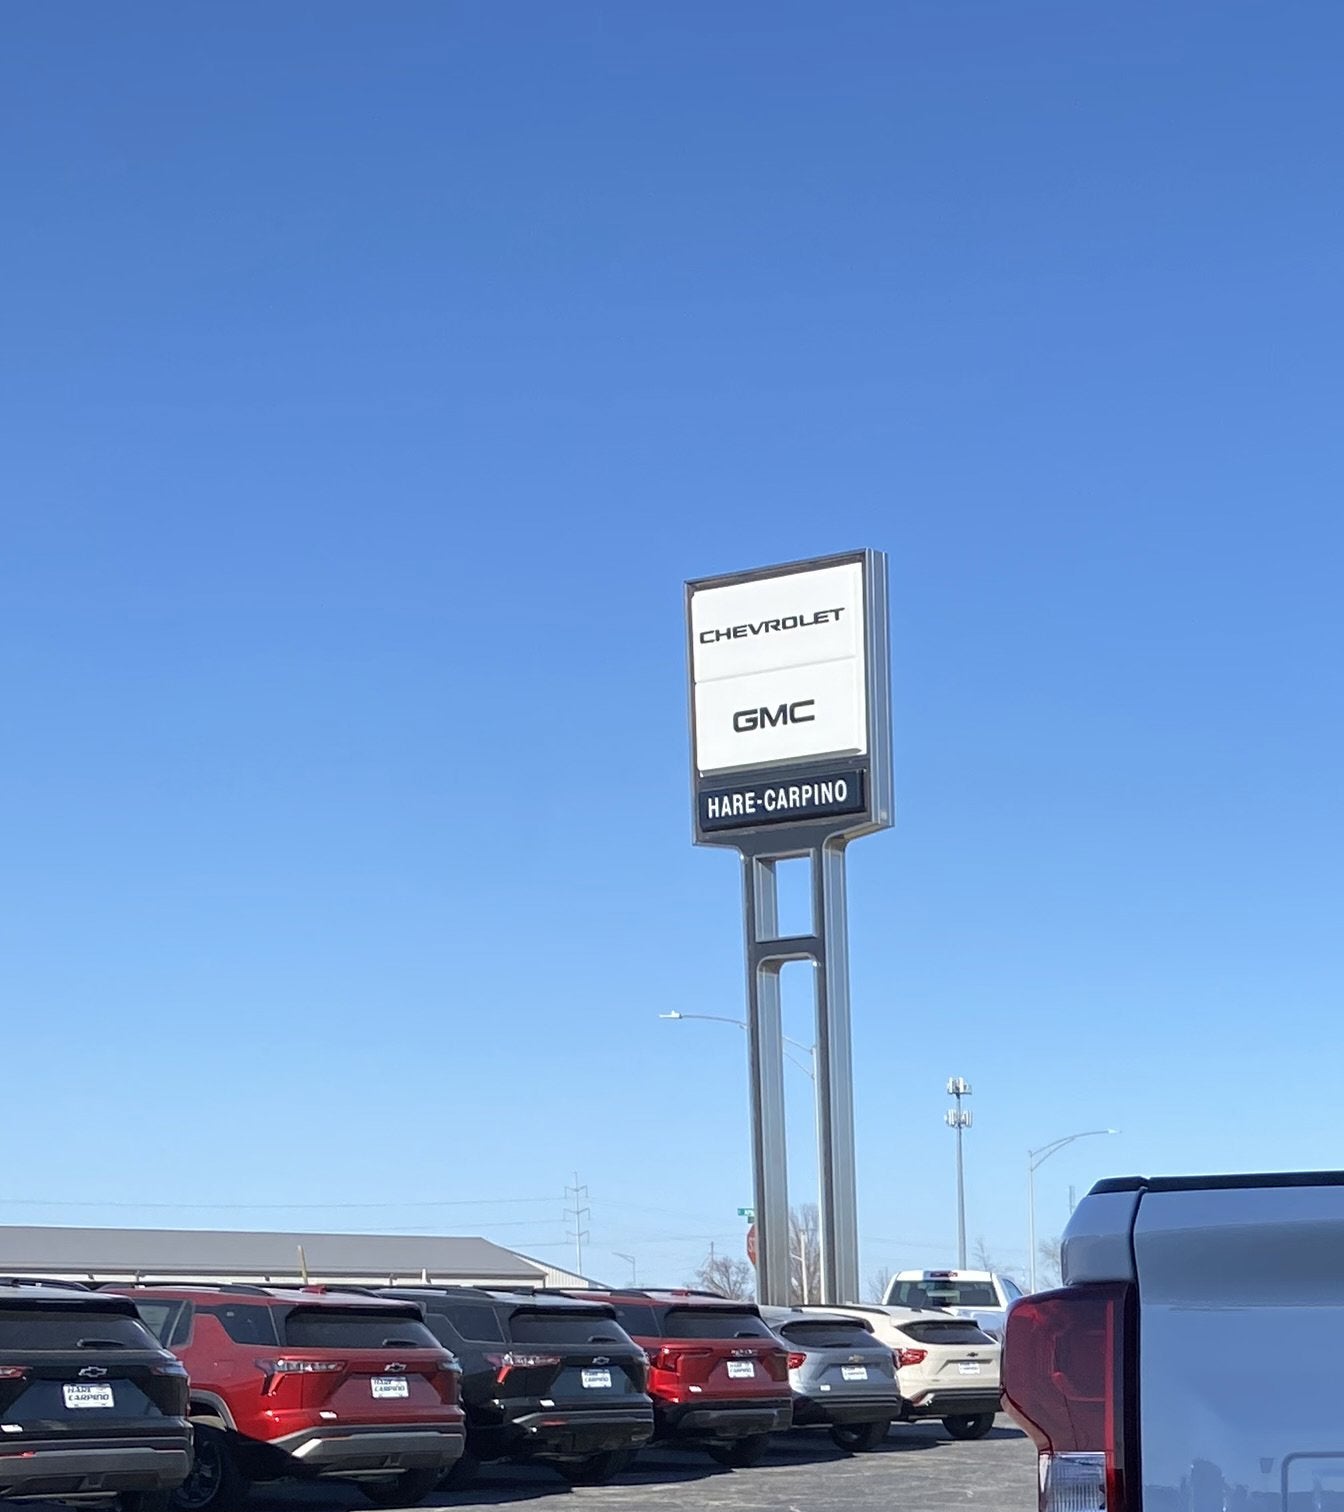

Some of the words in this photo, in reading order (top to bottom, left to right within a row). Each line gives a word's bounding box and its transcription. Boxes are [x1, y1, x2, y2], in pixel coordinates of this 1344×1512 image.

[700, 608, 844, 642] CHEVROLET
[733, 699, 815, 733] GMC
[708, 780, 848, 819] HARE-CARPINO
